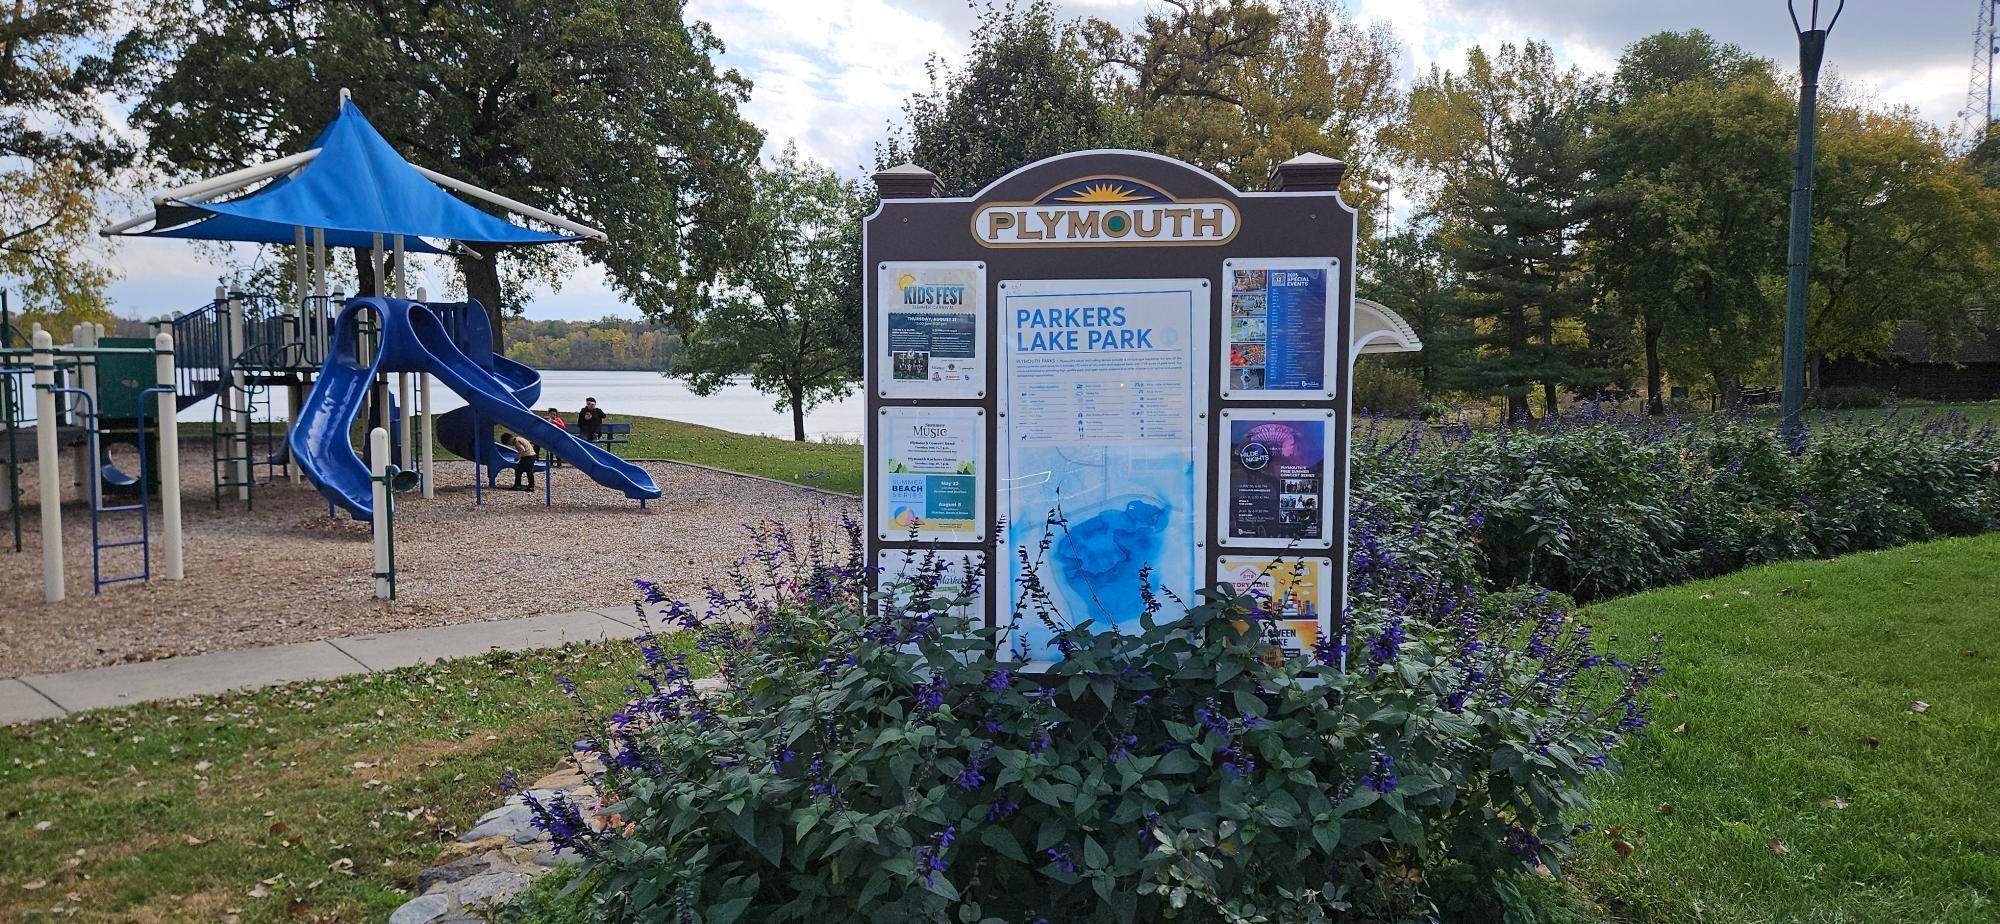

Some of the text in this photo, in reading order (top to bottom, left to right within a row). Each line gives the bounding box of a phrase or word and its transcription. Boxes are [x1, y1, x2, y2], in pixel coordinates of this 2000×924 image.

[988, 208, 1224, 240] PLYMOUTH
[904, 287, 965, 305] KIDS FEST
[1016, 306, 1127, 329] PARKERS
[1017, 328, 1153, 351] LAKE PARK
